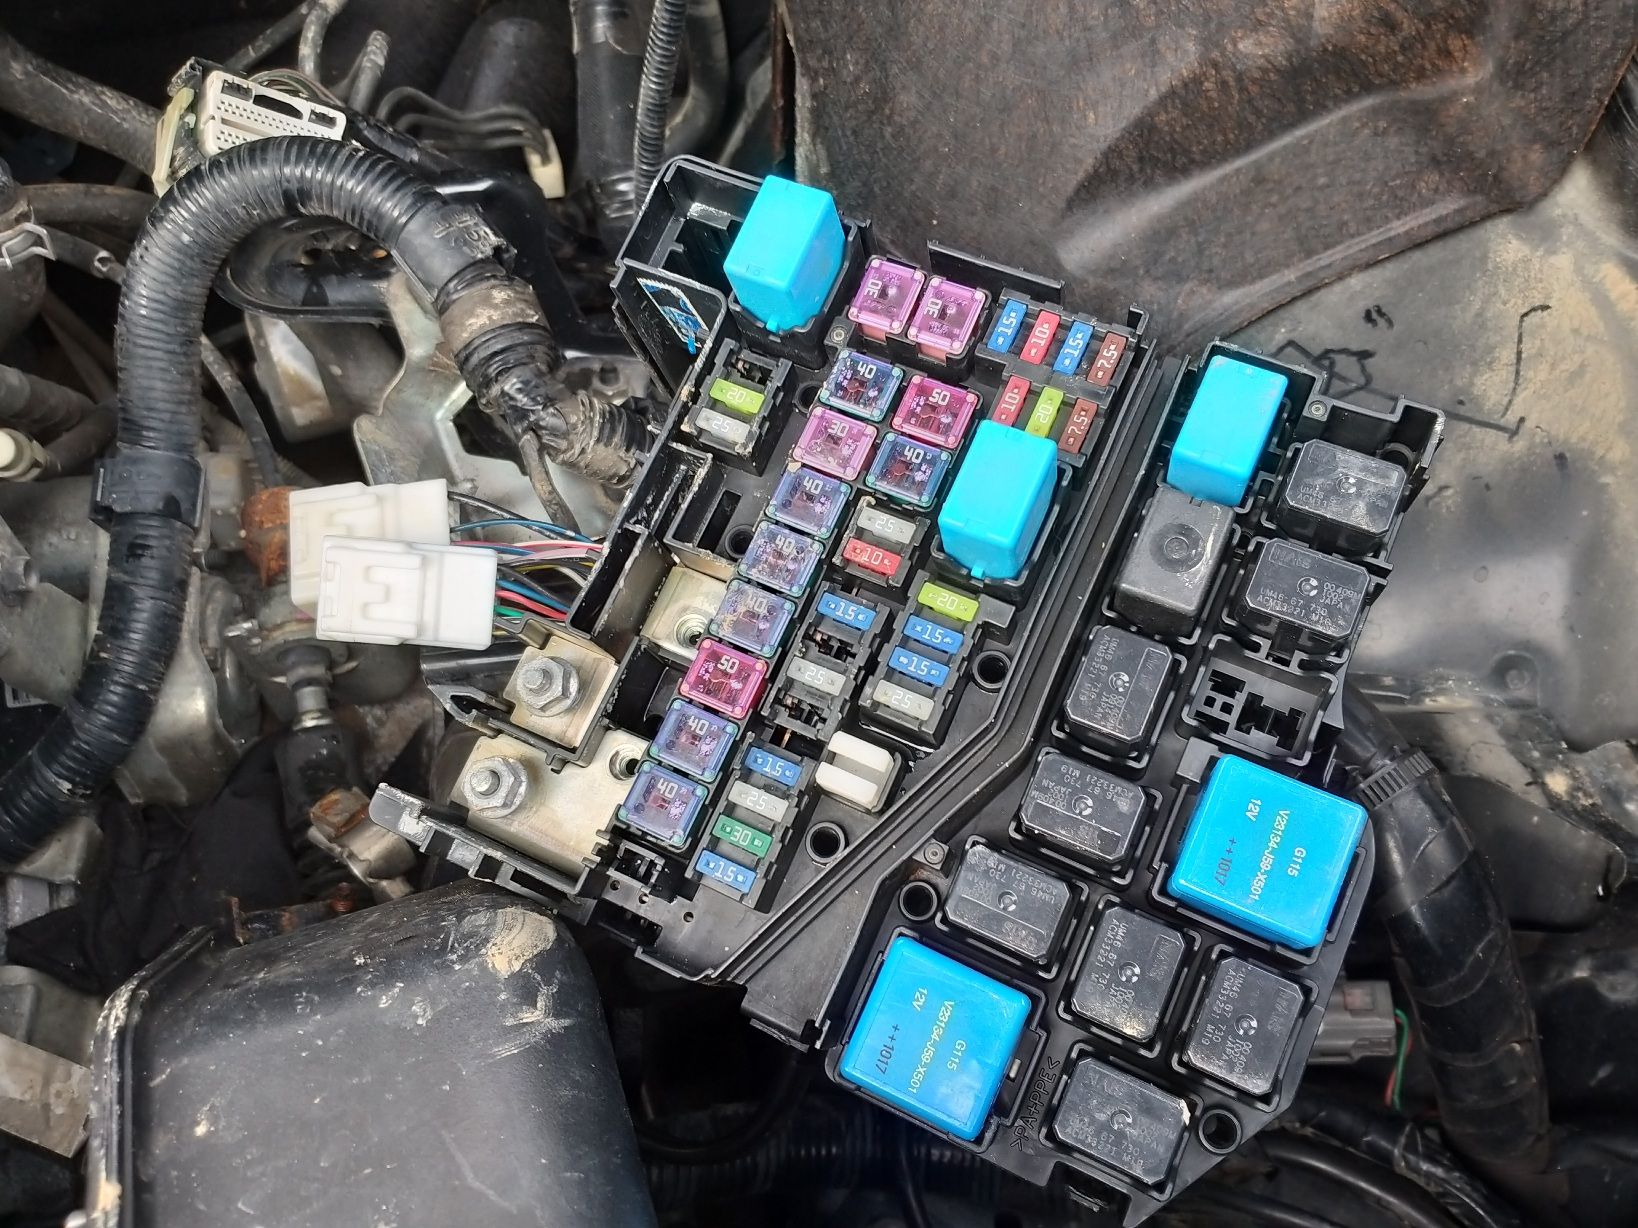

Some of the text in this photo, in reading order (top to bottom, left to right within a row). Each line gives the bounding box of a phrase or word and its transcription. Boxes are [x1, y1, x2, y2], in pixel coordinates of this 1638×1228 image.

[864, 279, 882, 298] 30
[924, 298, 943, 318] 30
[997, 315, 1017, 337] 15
[1031, 327, 1049, 347] 10
[1064, 337, 1083, 358] 15
[1097, 348, 1118, 368] 7.5
[857, 361, 877, 379] 40
[726, 387, 747, 403] 20
[929, 388, 950, 406] 50
[1001, 392, 1020, 412] 10
[1035, 404, 1054, 424] 20
[711, 416, 733, 433] 25
[827, 420, 850, 437] 30
[1068, 415, 1088, 434] 7.5
[904, 445, 924, 464] 40
[803, 476, 824, 494] 40
[875, 515, 896, 533] 25
[775, 534, 796, 555] 40
[862, 547, 883, 565] 10
[745, 593, 767, 612] 40
[835, 601, 857, 620] 15
[936, 592, 959, 611] 20
[921, 624, 944, 644] 15
[717, 654, 740, 674] 50
[908, 656, 930, 676] 15
[1097, 664, 1109, 677] 67
[804, 666, 826, 685] 25
[891, 690, 913, 709] 25
[688, 715, 710, 735] 40
[763, 757, 785, 777] 15
[656, 778, 679, 799] 40
[1041, 777, 1072, 795] JAPAN
[1062, 773, 1082, 787] 730
[1087, 783, 1100, 795] 67
[746, 791, 767, 812] 25
[1245, 799, 1262, 821] 12V
[729, 825, 752, 846] 30
[714, 861, 736, 882] 15
[1287, 847, 1307, 877] G115
[987, 868, 1007, 882] 730
[1094, 917, 1120, 967] ACM33221
[1112, 921, 1129, 948] UM46
[1104, 952, 1117, 967] 67
[912, 986, 928, 1012] 12V
[1211, 972, 1245, 1043] UM46 67 730
[947, 1040, 967, 1071] G115
[1099, 1130, 1115, 1143] 67
[1120, 1140, 1141, 1156] 730
